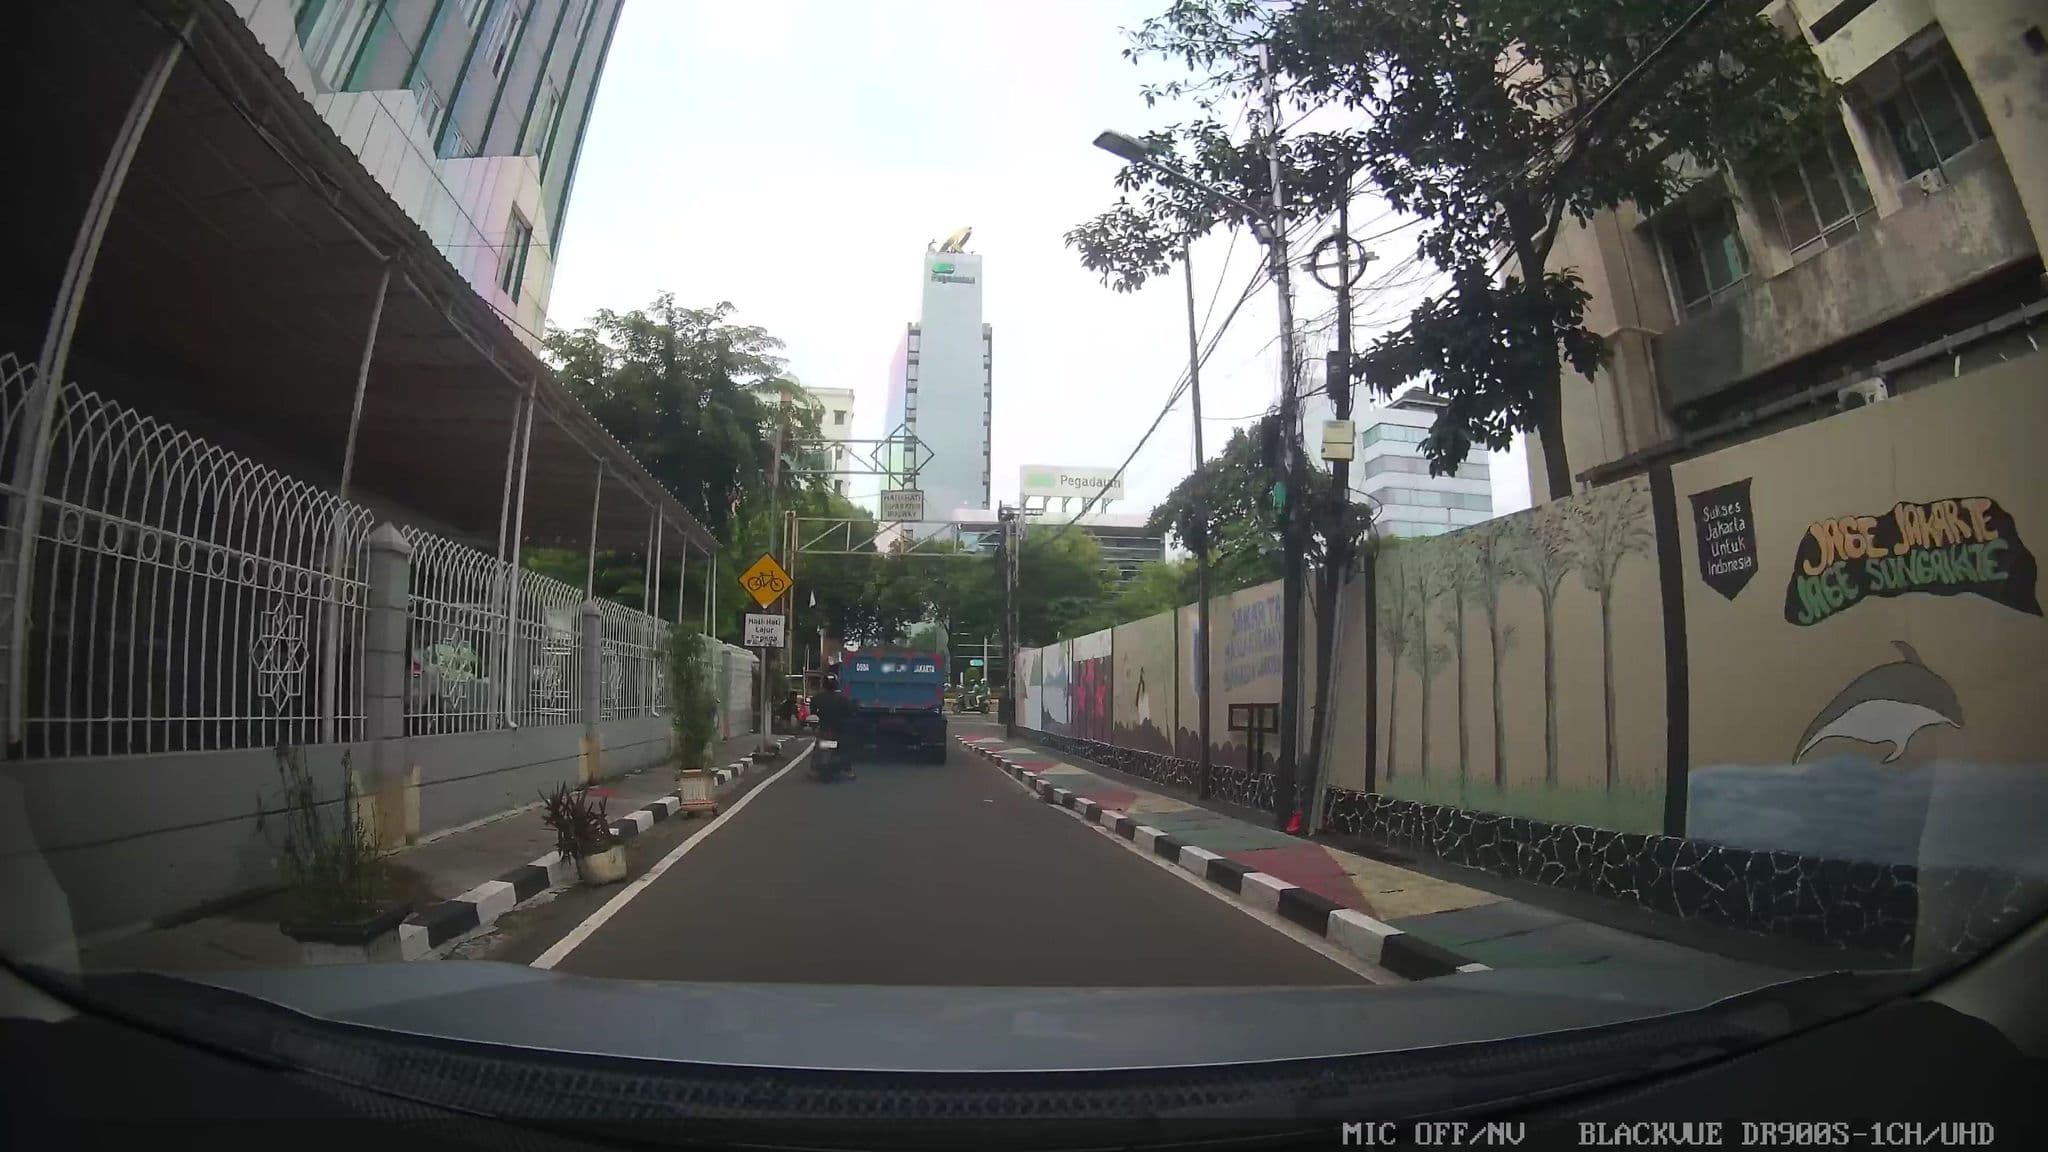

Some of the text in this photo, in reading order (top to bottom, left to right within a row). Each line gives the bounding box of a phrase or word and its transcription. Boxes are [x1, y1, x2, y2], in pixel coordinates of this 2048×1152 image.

[1703, 502, 1741, 522] Sukses
[1706, 516, 1746, 541] Jakarta
[1711, 535, 1746, 557] Untuk
[1803, 516, 1888, 576] JAGE
[1707, 556, 1752, 577] Indonesia
[1797, 560, 1860, 624] JAGE
